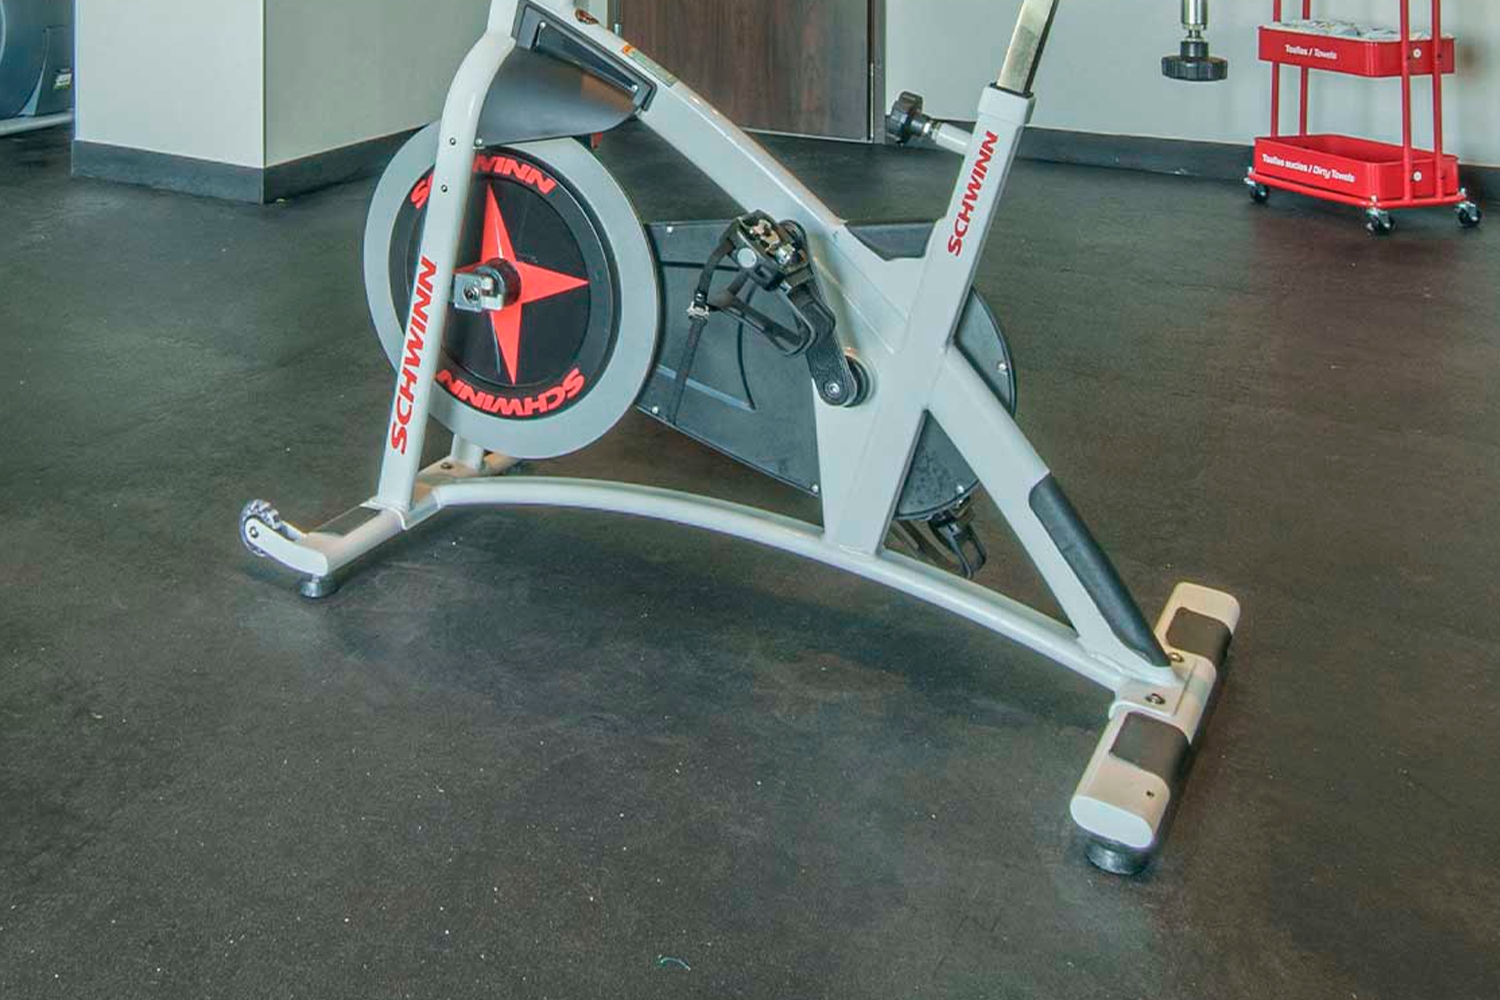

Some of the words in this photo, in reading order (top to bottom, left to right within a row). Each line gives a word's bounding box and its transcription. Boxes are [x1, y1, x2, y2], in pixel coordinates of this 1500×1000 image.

[947, 130, 998, 257] SCHWINN
[391, 255, 437, 455] SCHWINN
[436, 368, 585, 417] SCHWINN
